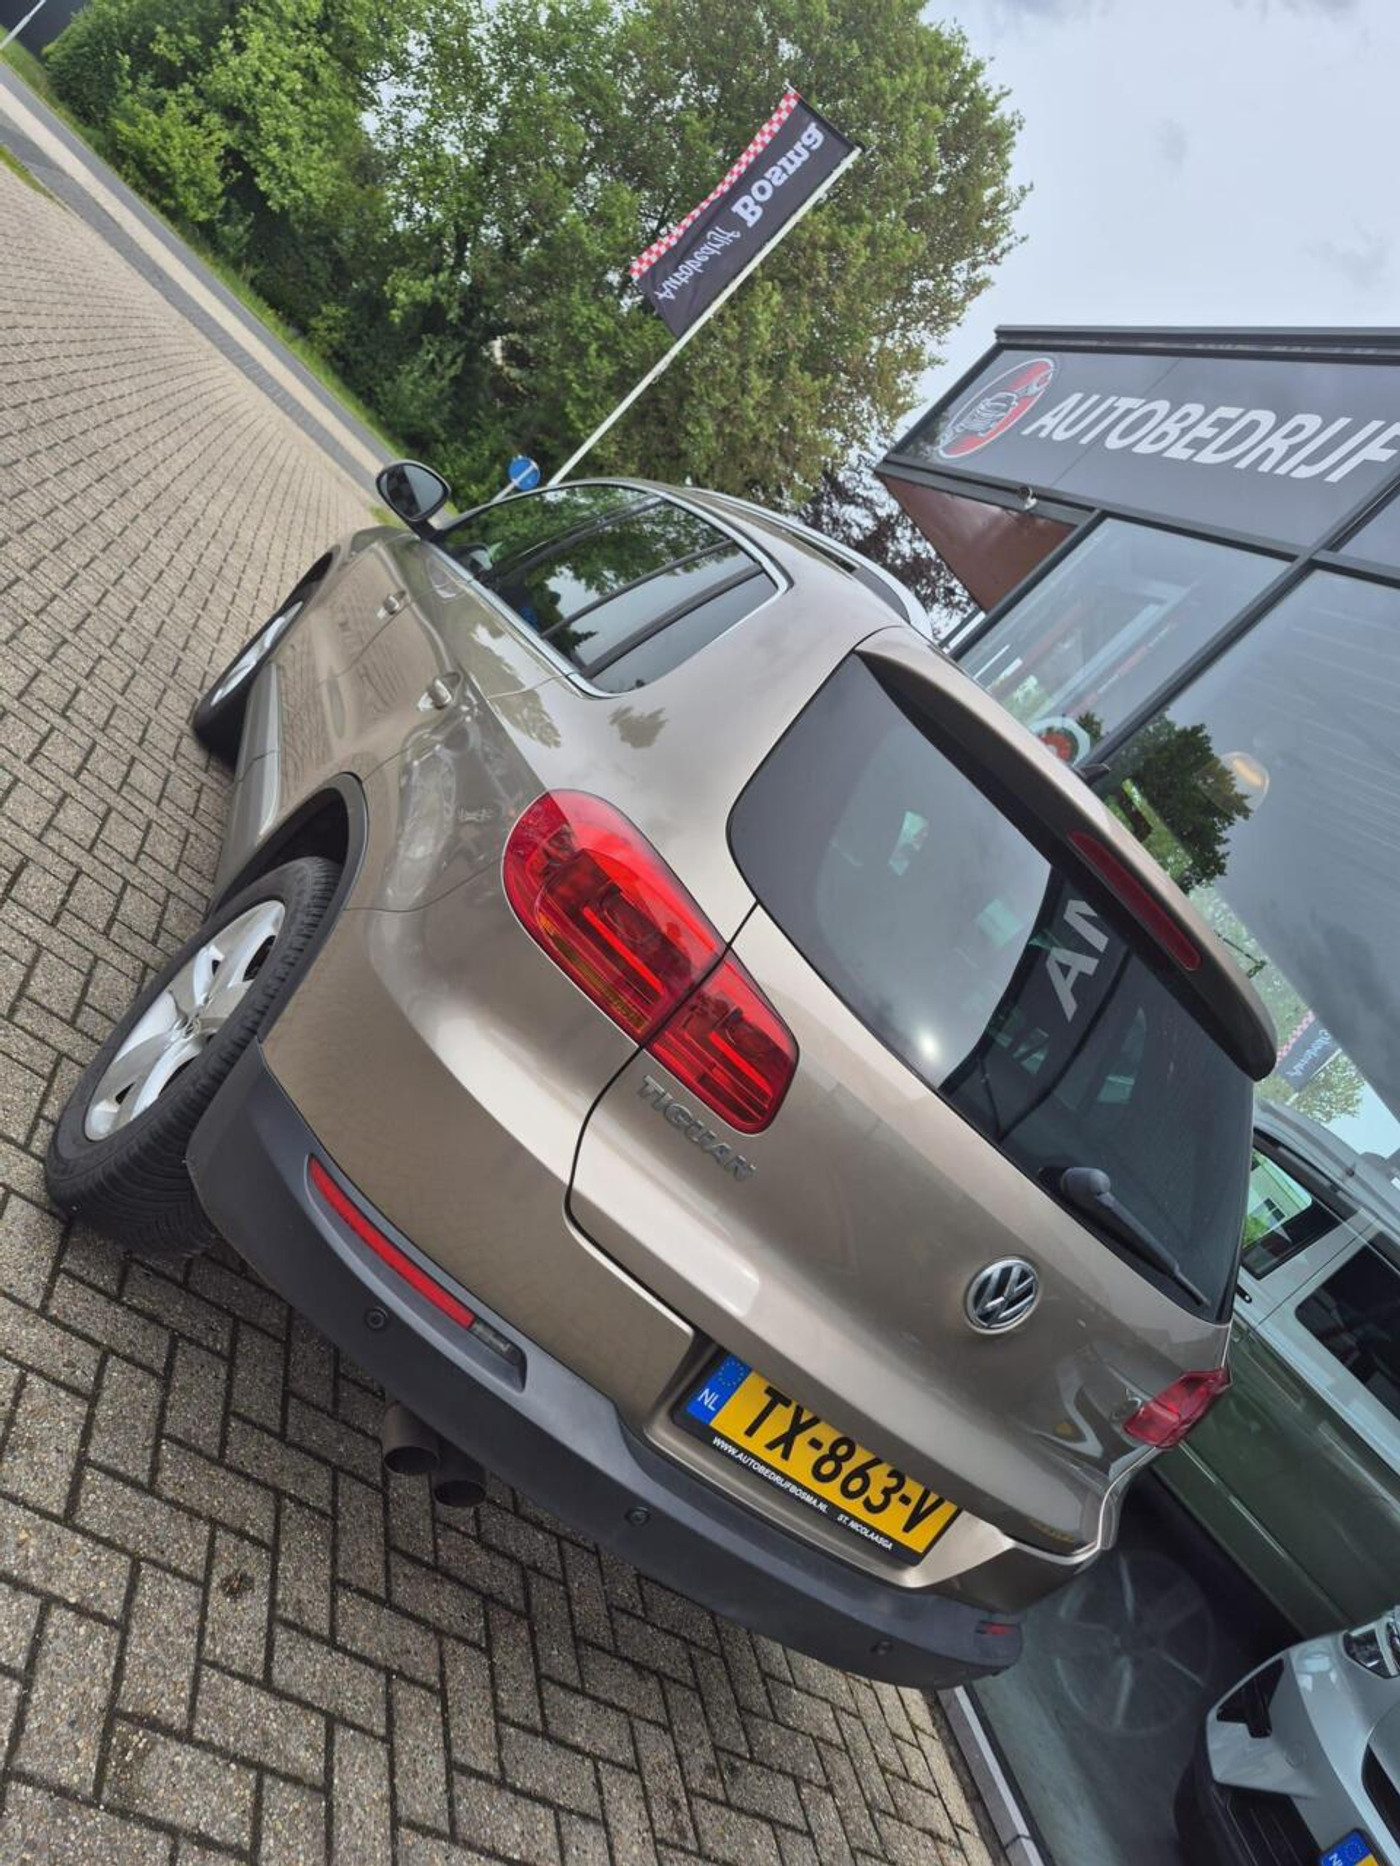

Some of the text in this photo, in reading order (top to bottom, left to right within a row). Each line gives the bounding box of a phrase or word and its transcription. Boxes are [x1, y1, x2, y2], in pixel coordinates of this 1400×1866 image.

[1022, 392, 1400, 482] AUTOBEDRIJF
[638, 1075, 756, 1182] TIGUAN
[697, 1387, 719, 1411] NL
[744, 1386, 946, 1534] TX-863-V
